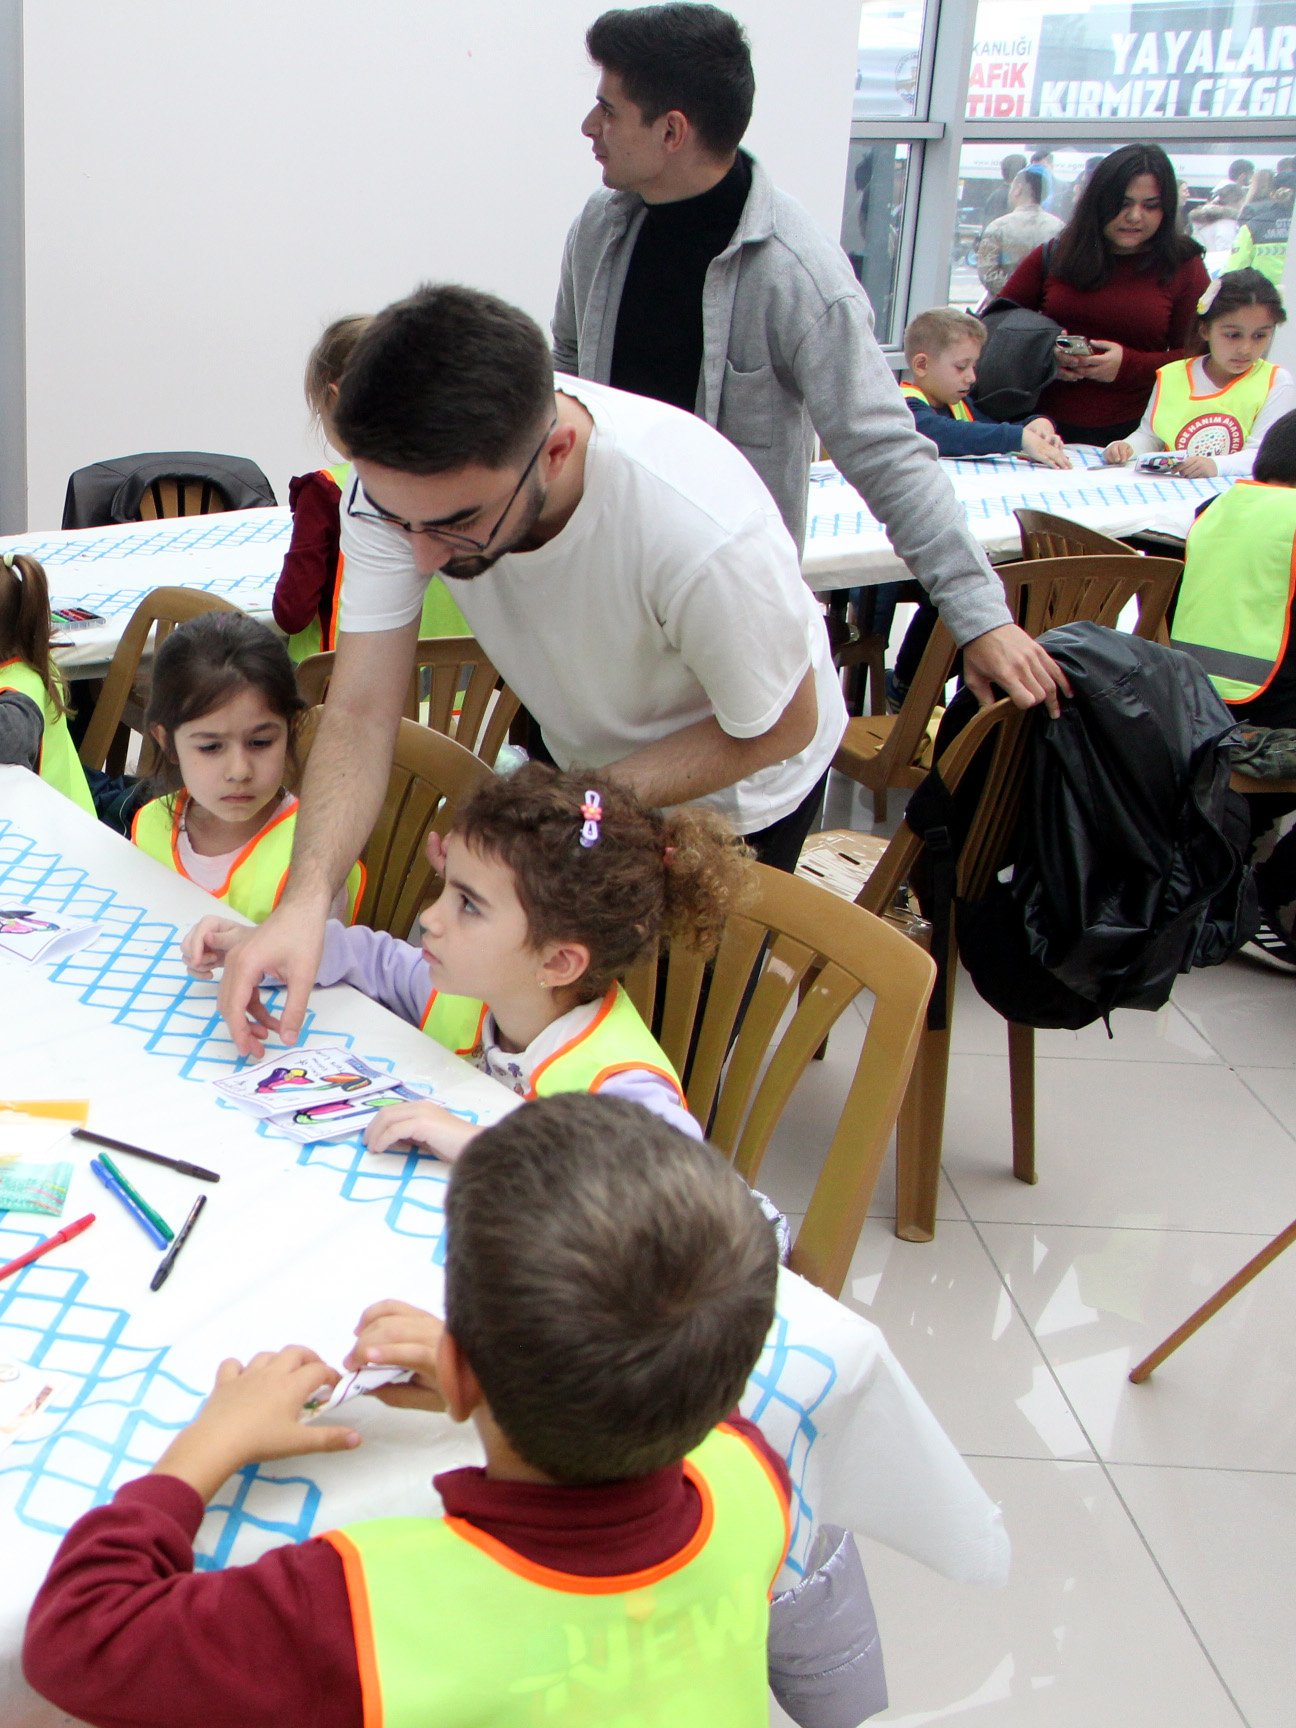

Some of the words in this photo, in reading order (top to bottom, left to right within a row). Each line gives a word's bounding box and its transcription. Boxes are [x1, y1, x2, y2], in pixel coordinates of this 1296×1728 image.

[1111, 25, 1296, 75] YAYALAR
[1039, 79, 1180, 118] KIRMIZI
[1188, 416, 1222, 433] HANIM
